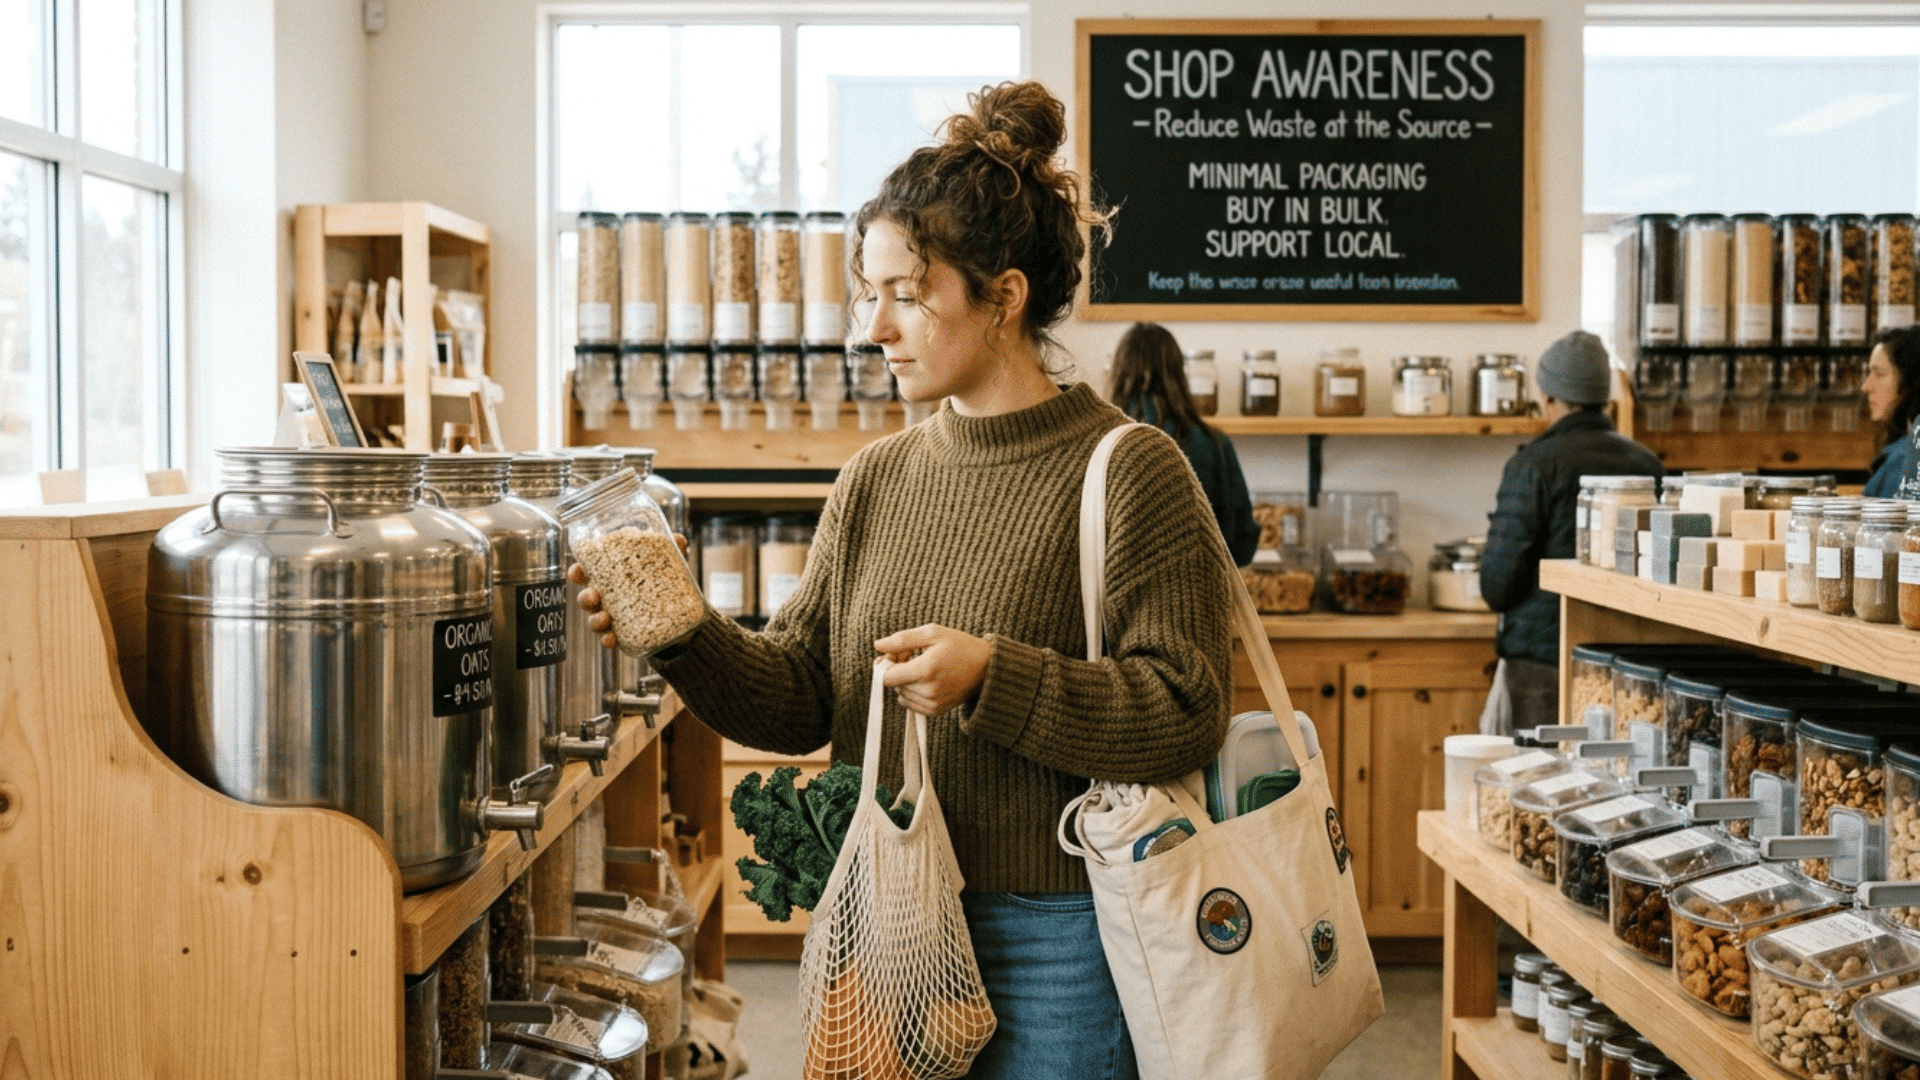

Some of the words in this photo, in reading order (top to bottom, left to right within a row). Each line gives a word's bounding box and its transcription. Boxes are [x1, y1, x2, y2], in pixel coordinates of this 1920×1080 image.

[1124, 48, 1235, 100] SHOP
[1251, 49, 1495, 101] AWARENESS
[1246, 108, 1317, 138] Waste
[1324, 110, 1348, 138] at
[1354, 110, 1391, 138] the
[1188, 162, 1289, 190] MINIMAL
[1299, 162, 1427, 191] PACKAGING
[1226, 195, 1275, 225] BUY
[1285, 196, 1310, 225] IN
[1205, 229, 1312, 259] SUPPORT
[461, 648, 490, 676] OATS
